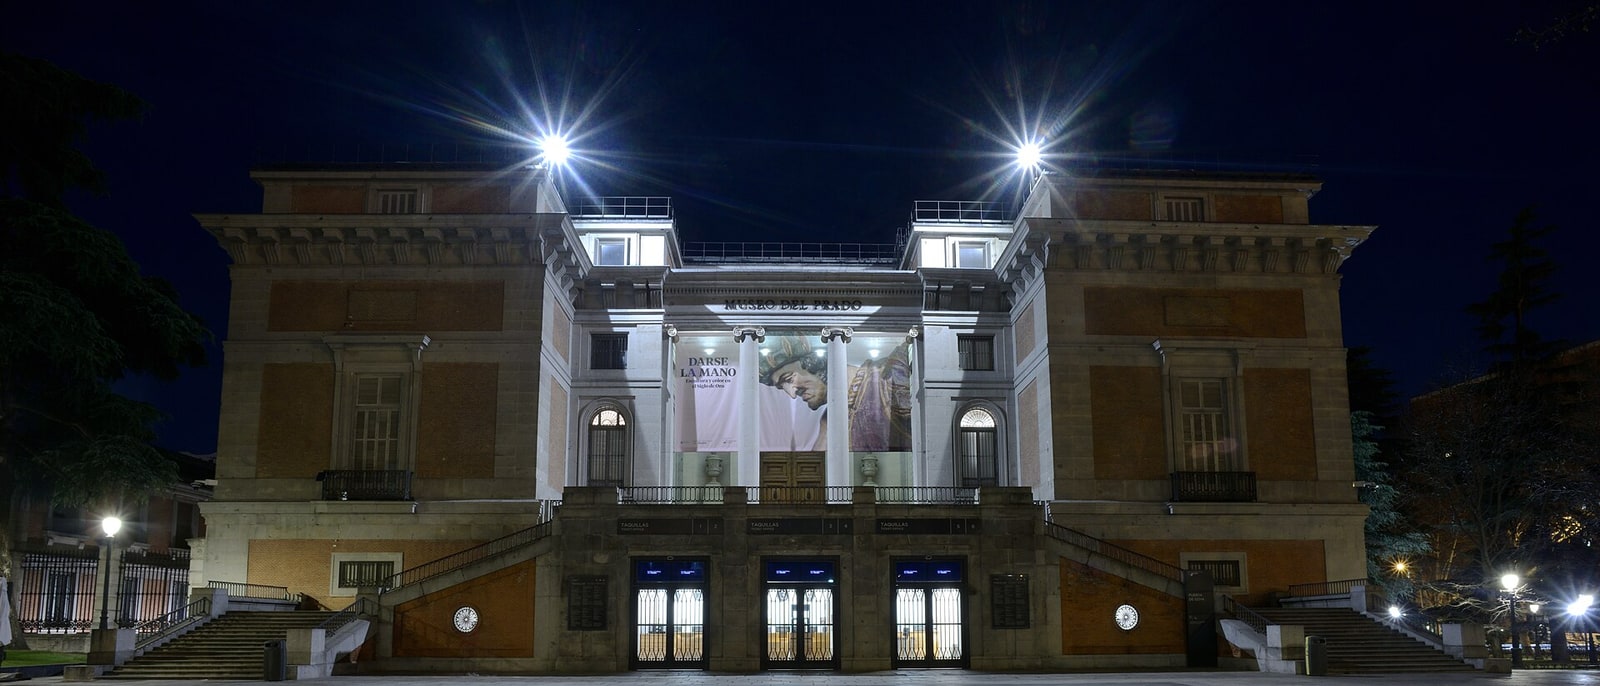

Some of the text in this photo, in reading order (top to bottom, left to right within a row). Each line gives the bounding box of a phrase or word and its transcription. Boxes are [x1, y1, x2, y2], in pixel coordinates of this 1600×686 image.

[725, 299, 862, 311] MUSEO DEL PRADO
[688, 357, 729, 367] DARSE
[680, 367, 737, 378] LA MANO
